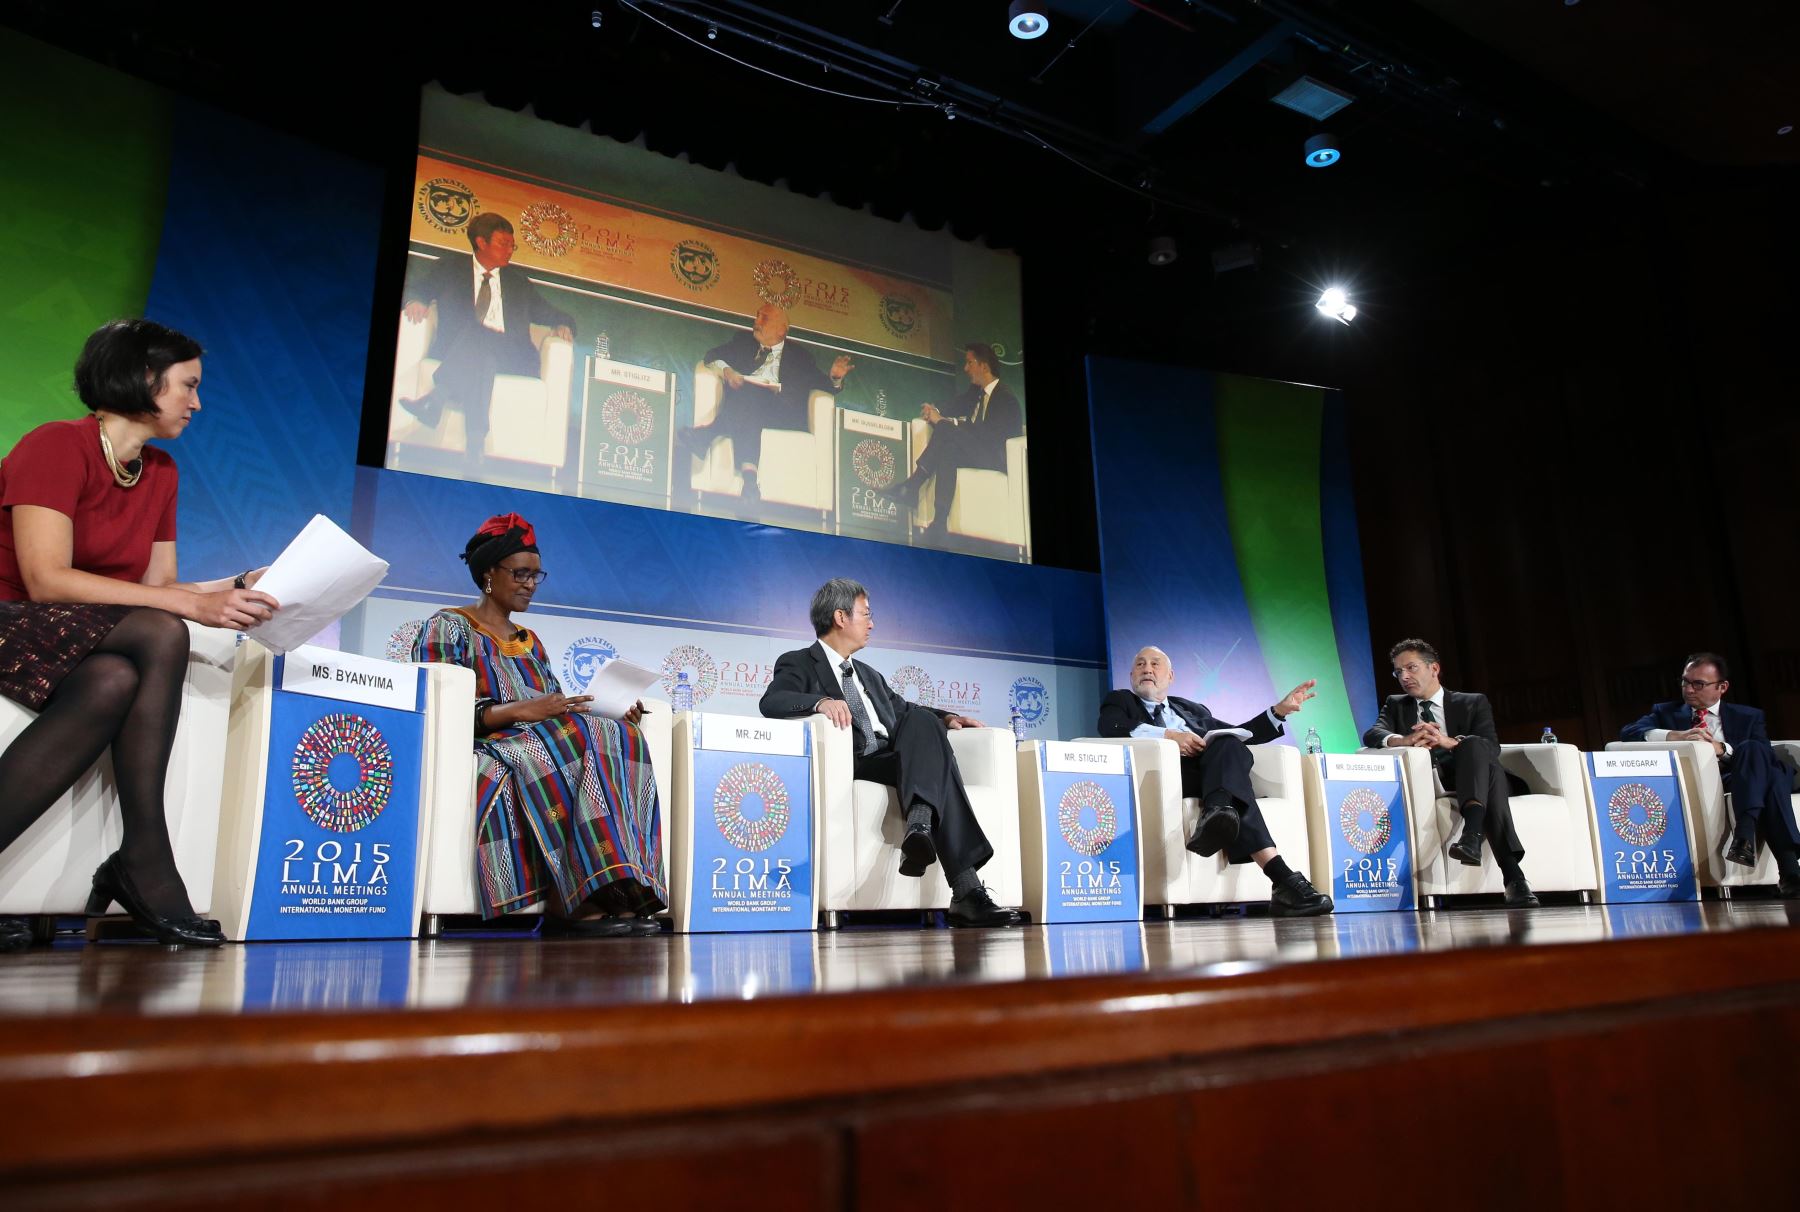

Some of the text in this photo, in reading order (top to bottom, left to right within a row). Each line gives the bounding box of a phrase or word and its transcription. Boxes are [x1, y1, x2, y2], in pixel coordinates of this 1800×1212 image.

[581, 232, 634, 252] LIMA
[599, 442, 655, 460] 2015
[598, 451, 655, 471] LIMA
[851, 495, 897, 511] LIMA
[562, 635, 621, 661] INTERNATIONA
[720, 661, 774, 675] 2015
[311, 664, 394, 691] MS. BYANYIMA
[720, 670, 775, 684] LIMA
[937, 680, 982, 692] 2015
[937, 689, 982, 701] LIMA
[735, 728, 772, 741] MR. ZHU
[1064, 752, 1108, 764] MR. STIGLITZ
[1606, 759, 1658, 768] MR. VIDEGARAY
[283, 839, 391, 864] 2015
[1614, 849, 1675, 862] 2015
[711, 857, 792, 875] 2015
[1060, 860, 1121, 875] 2015
[1343, 857, 1397, 871] 2015
[1615, 861, 1677, 874] LIMA
[281, 860, 389, 885] LIMA
[1344, 869, 1398, 883] LIMA
[711, 873, 792, 890] LIMA
[1060, 874, 1122, 889] LIMA
[281, 884, 387, 896] ANNUAL MEETINGS
[712, 890, 792, 899] ANNUAL MEETINGS
[1089, 887, 1122, 895] MEETINGS
[345, 898, 368, 906] GROUP
[280, 906, 387, 914] INTERNATIONAL MONETARY FUND
